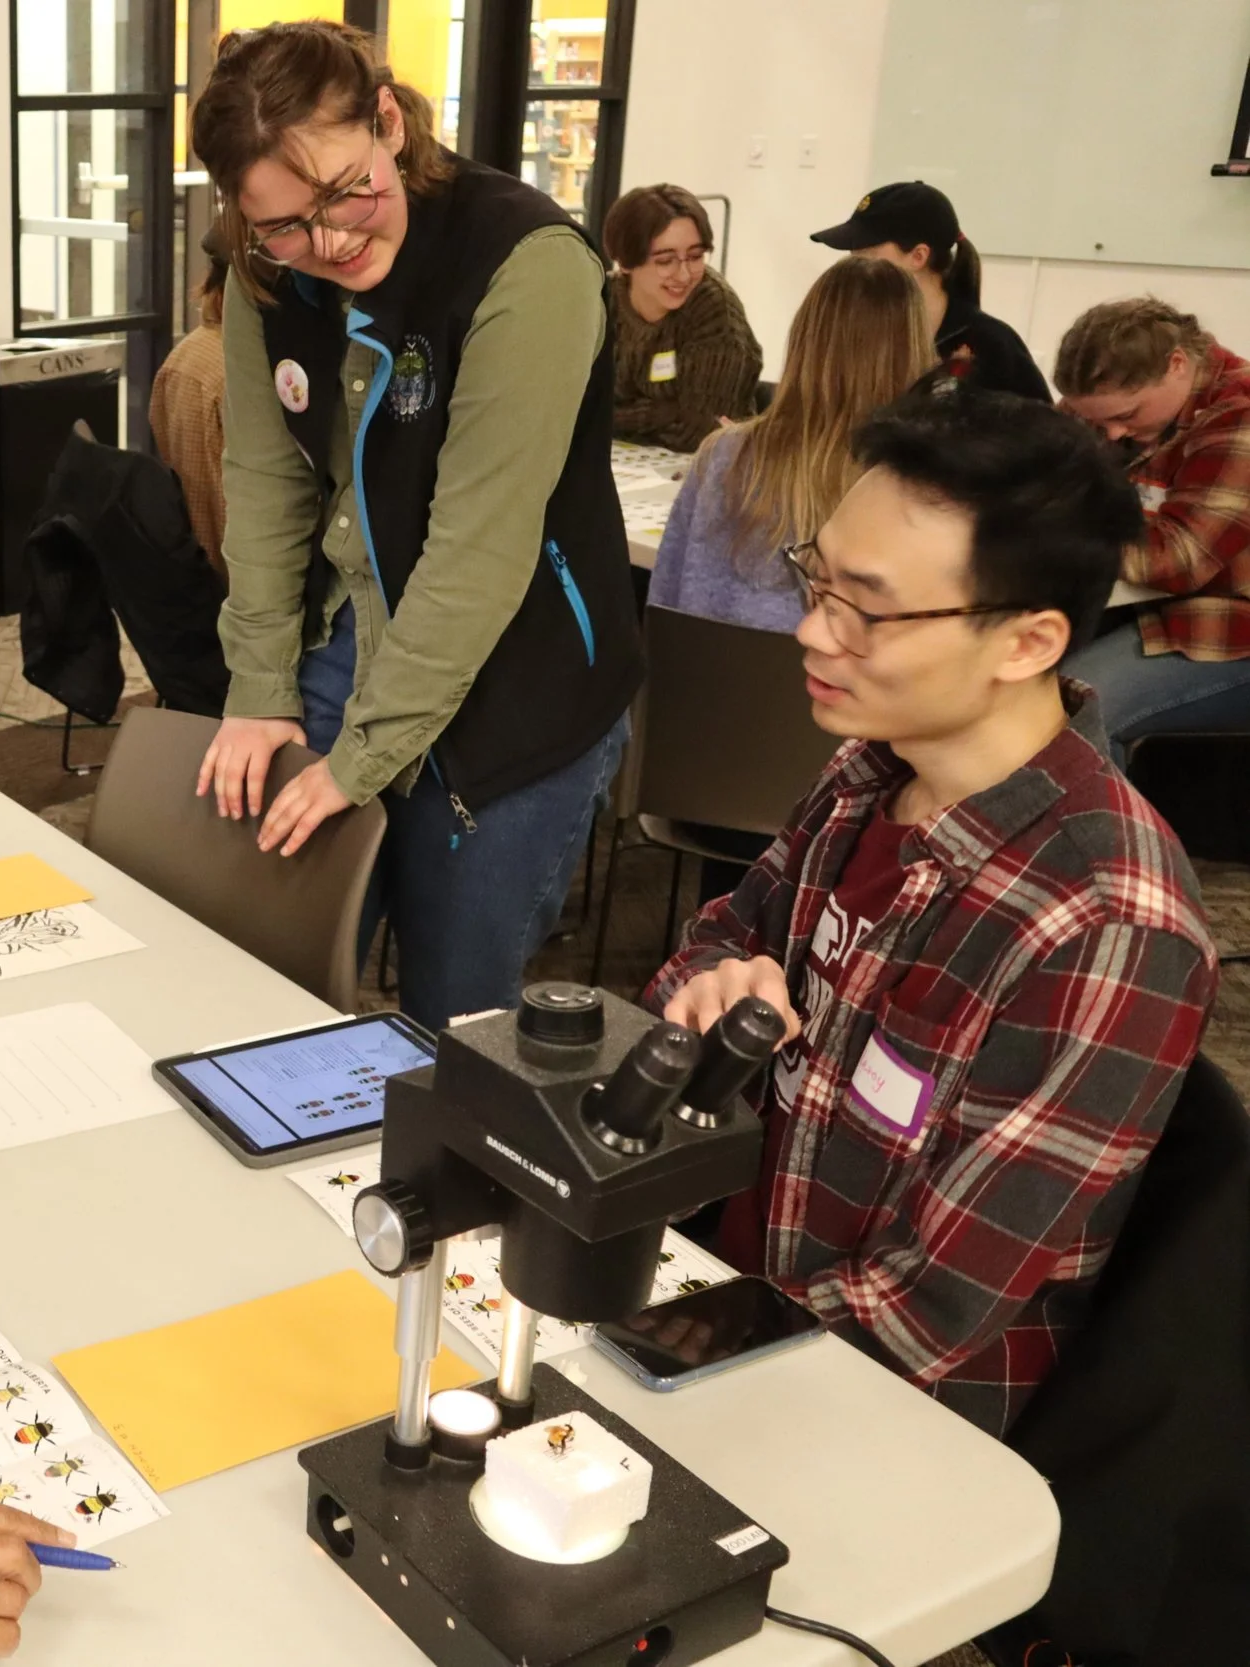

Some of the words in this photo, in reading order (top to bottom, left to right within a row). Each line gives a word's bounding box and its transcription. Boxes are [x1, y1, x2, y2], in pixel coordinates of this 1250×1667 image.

[39, 353, 84, 375] CANS
[486, 1135, 522, 1165] BAUSCH
[529, 1163, 557, 1188] LOMB
[460, 1315, 479, 1331] BEES
[478, 1330, 502, 1359] UMBLE
[23, 1369, 51, 1394] ALBERTA
